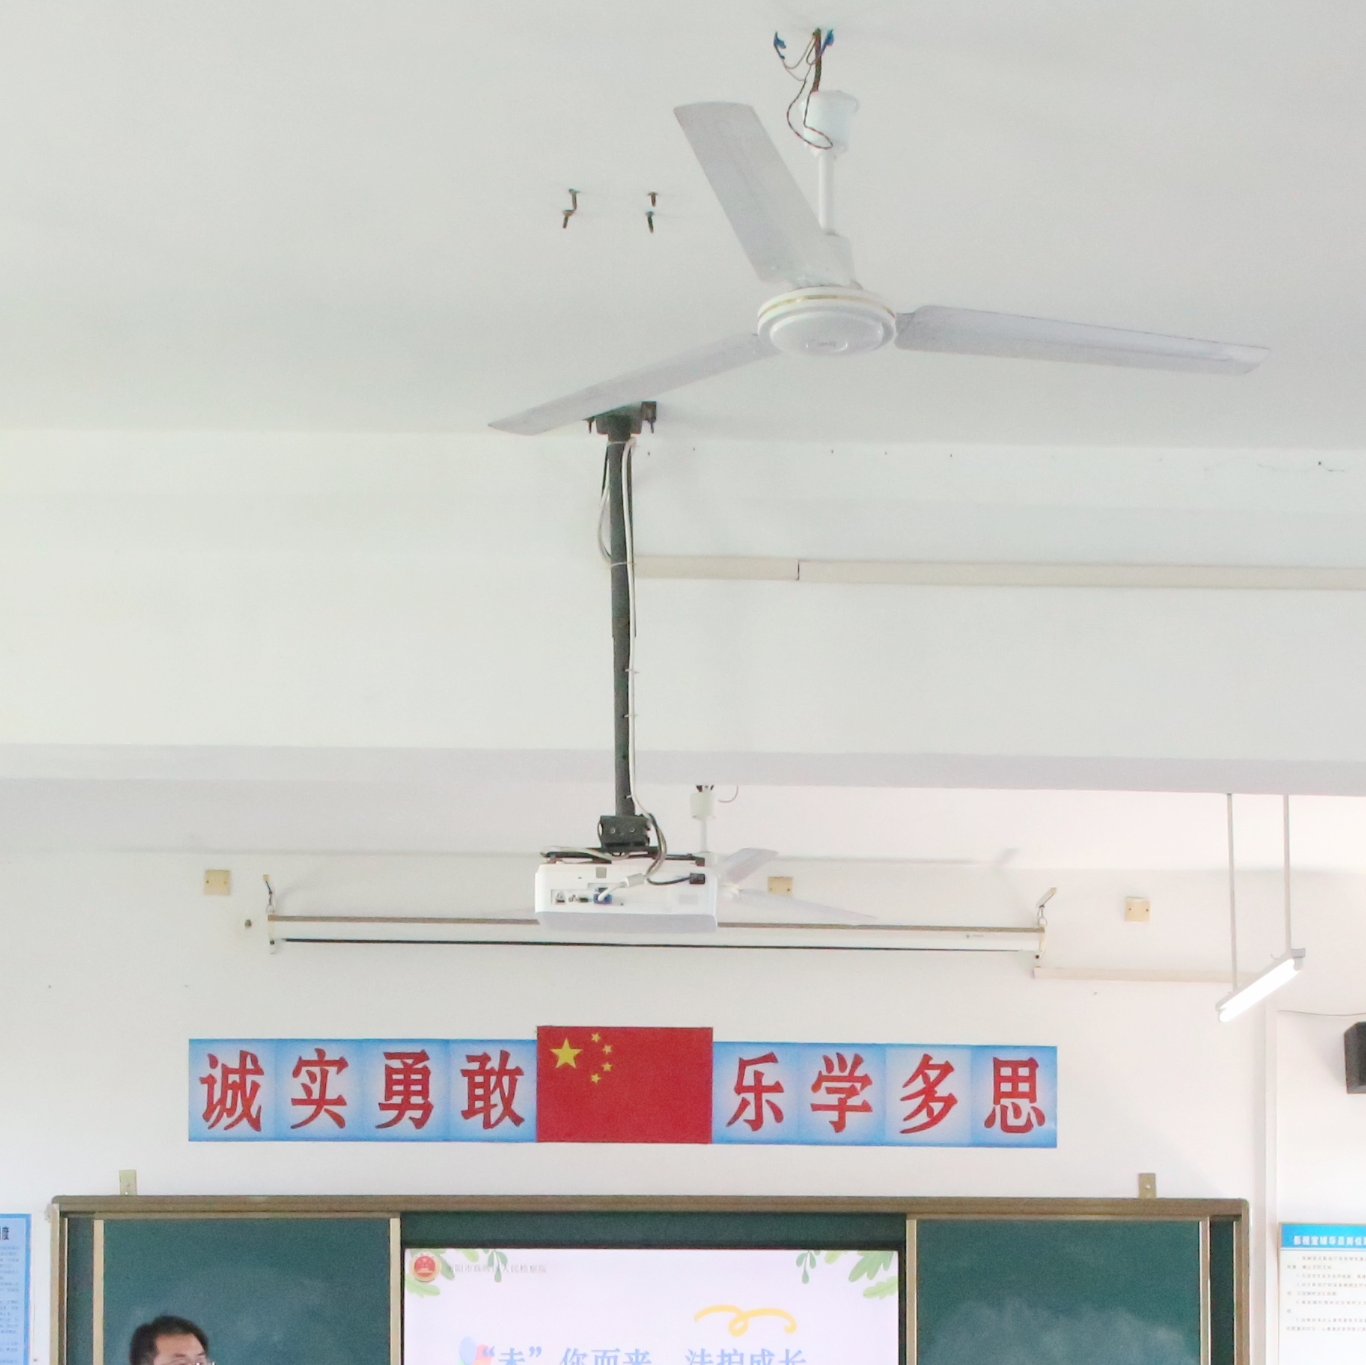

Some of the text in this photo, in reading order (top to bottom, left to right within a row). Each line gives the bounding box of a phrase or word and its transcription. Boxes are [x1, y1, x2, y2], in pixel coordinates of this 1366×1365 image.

[198, 1049, 1047, 1136] 诚实勇敢 乐学多思
[445, 1264, 547, 1274] 阳市珠晖人民检察院
